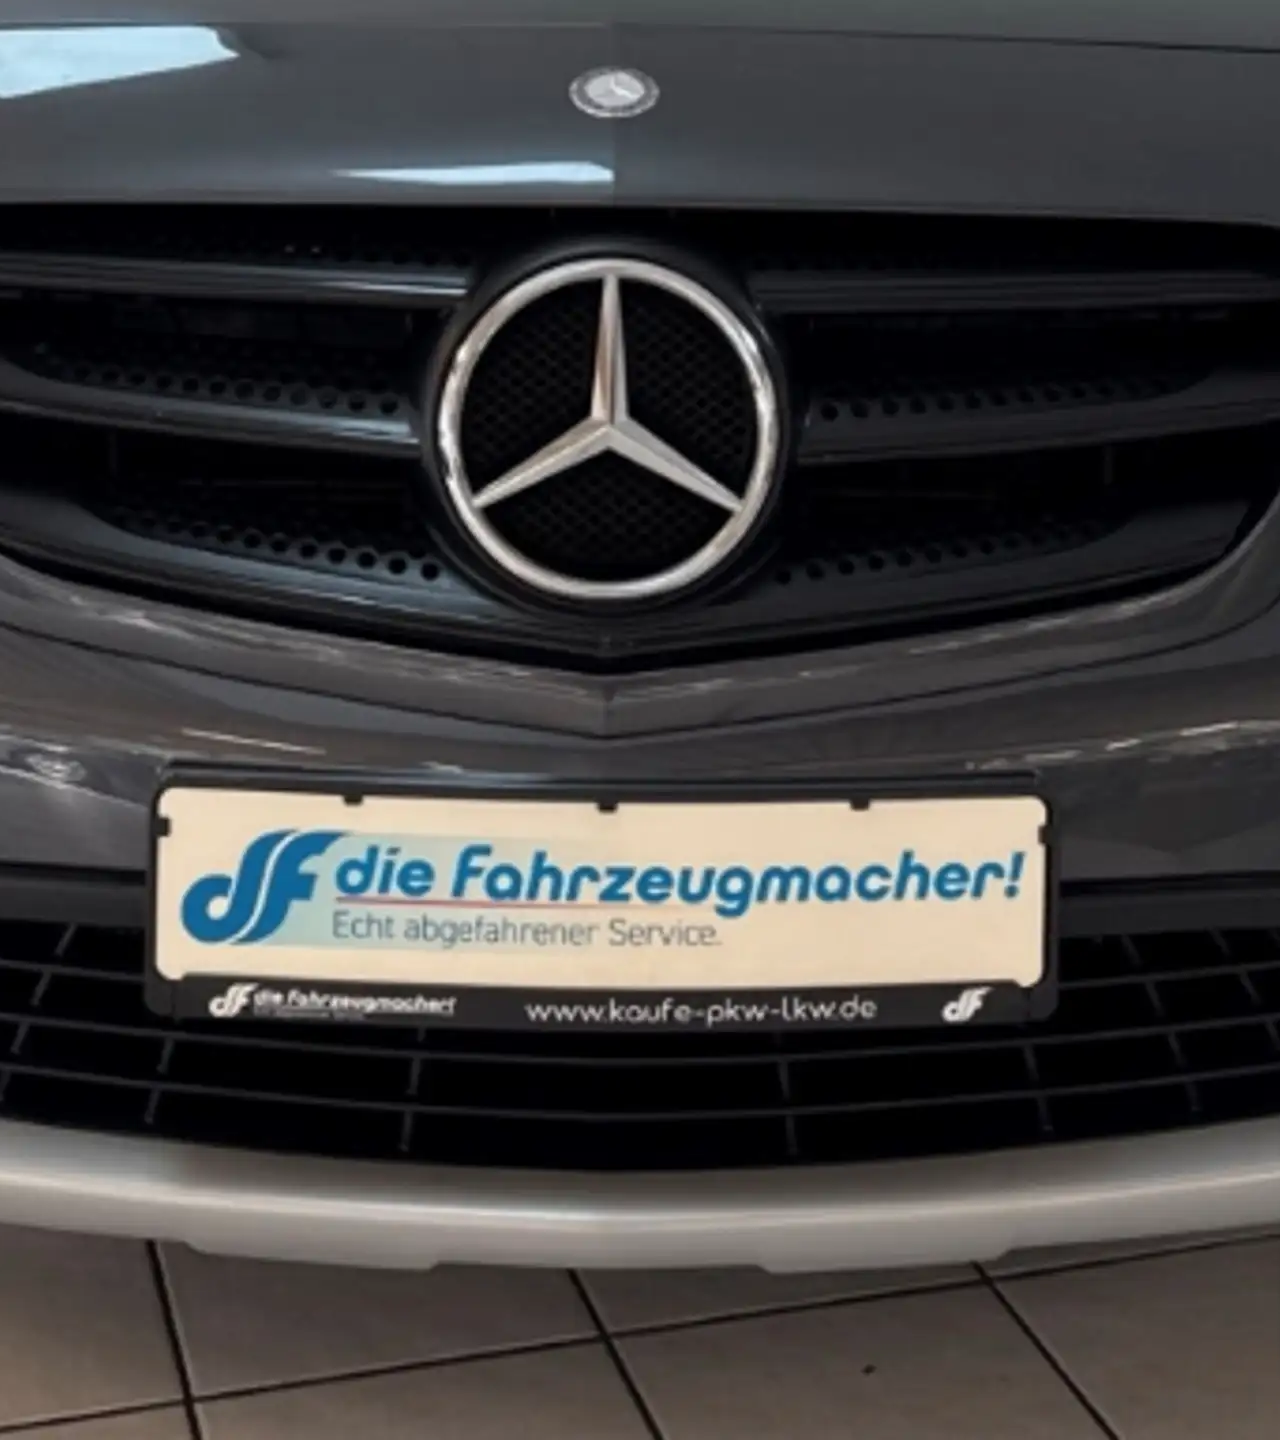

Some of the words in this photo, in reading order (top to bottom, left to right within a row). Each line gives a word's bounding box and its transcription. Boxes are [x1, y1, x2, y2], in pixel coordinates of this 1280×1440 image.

[334, 844, 436, 897] die
[450, 844, 1028, 918] Fahrzeugmacher!
[332, 910, 395, 940] Echt
[404, 912, 601, 949] abgefahrener
[608, 917, 723, 948] Service.
[524, 995, 879, 1028] www.kaufe-pkw-lkw.de
